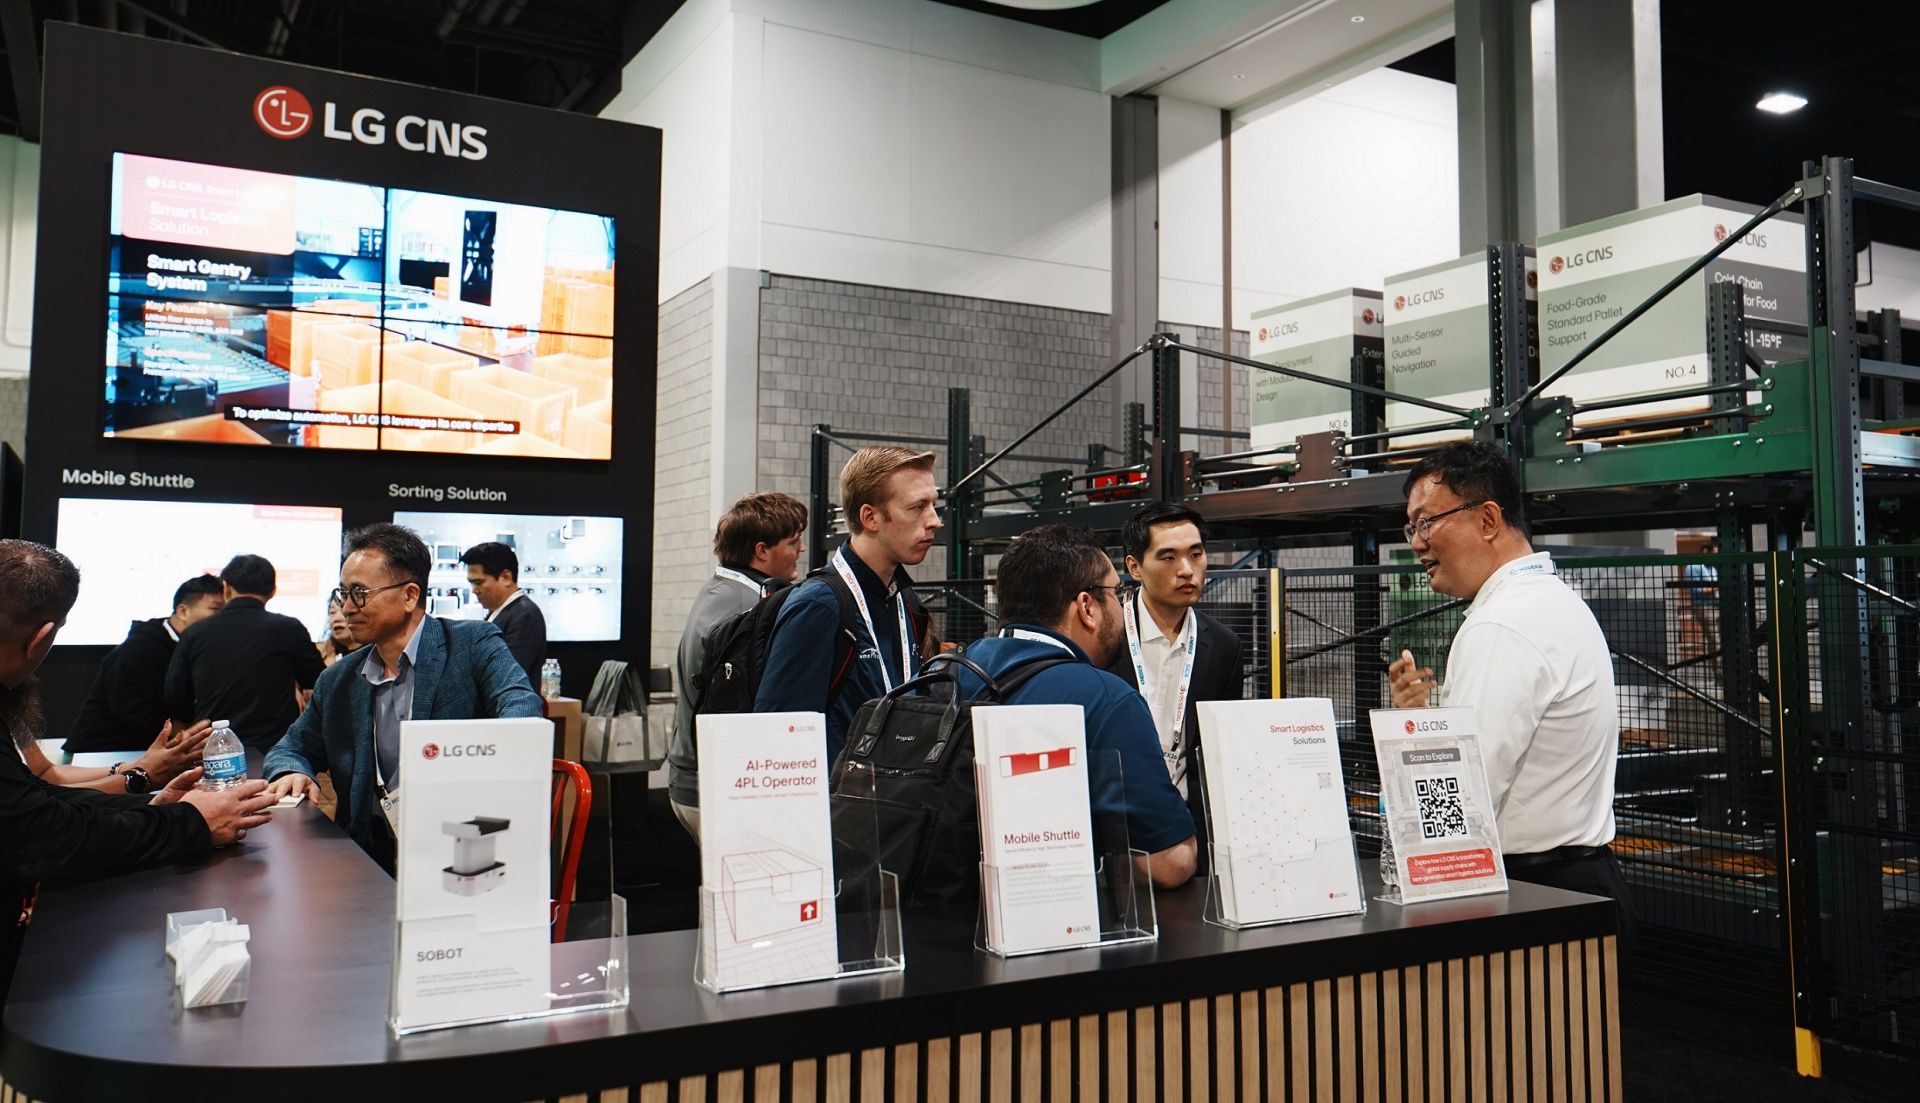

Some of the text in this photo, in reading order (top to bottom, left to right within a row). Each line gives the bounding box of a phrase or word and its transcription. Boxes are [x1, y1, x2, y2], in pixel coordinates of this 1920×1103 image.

[323, 102, 386, 145] LG
[395, 115, 488, 161] CNS
[149, 201, 198, 219] Smart
[149, 217, 209, 236] Solution
[1745, 233, 1767, 248] CNS
[1566, 246, 1613, 269] LG CNS
[147, 253, 252, 281] Smart Gantry
[146, 272, 208, 292] System
[1407, 288, 1444, 307] LG CNS
[1547, 293, 1607, 314] Food-Grade
[1756, 295, 1777, 310] Food
[1547, 311, 1593, 330] Standard
[1595, 306, 1623, 321] Pallet
[1269, 322, 1299, 338] LG CNS
[1391, 327, 1444, 345] Multi-Sensor
[1548, 331, 1587, 347] Support
[1391, 346, 1421, 360] Guided
[1392, 359, 1436, 374] Navigation
[1665, 364, 1697, 379] NO. 4
[1256, 379, 1269, 388] with
[1256, 391, 1278, 402] Design
[232, 406, 247, 418] To
[247, 409, 292, 421] optimize
[1343, 417, 1349, 427] 6
[62, 469, 195, 489] Mobile Shuttle
[388, 483, 507, 502] Sorting Solution
[1270, 723, 1325, 734] Smart Logistics
[1417, 720, 1449, 731] LG CNS
[1292, 737, 1326, 745] Solutions
[443, 744, 496, 757] LG CNS
[1409, 754, 1424, 762] Scan
[1432, 752, 1454, 762] Explore
[203, 759, 231, 771] agara
[746, 758, 817, 771] AI-Powered
[734, 776, 817, 789] 4PL Operator
[1004, 830, 1080, 845] Mobile Shuttle
[417, 947, 464, 962] SOBOT
